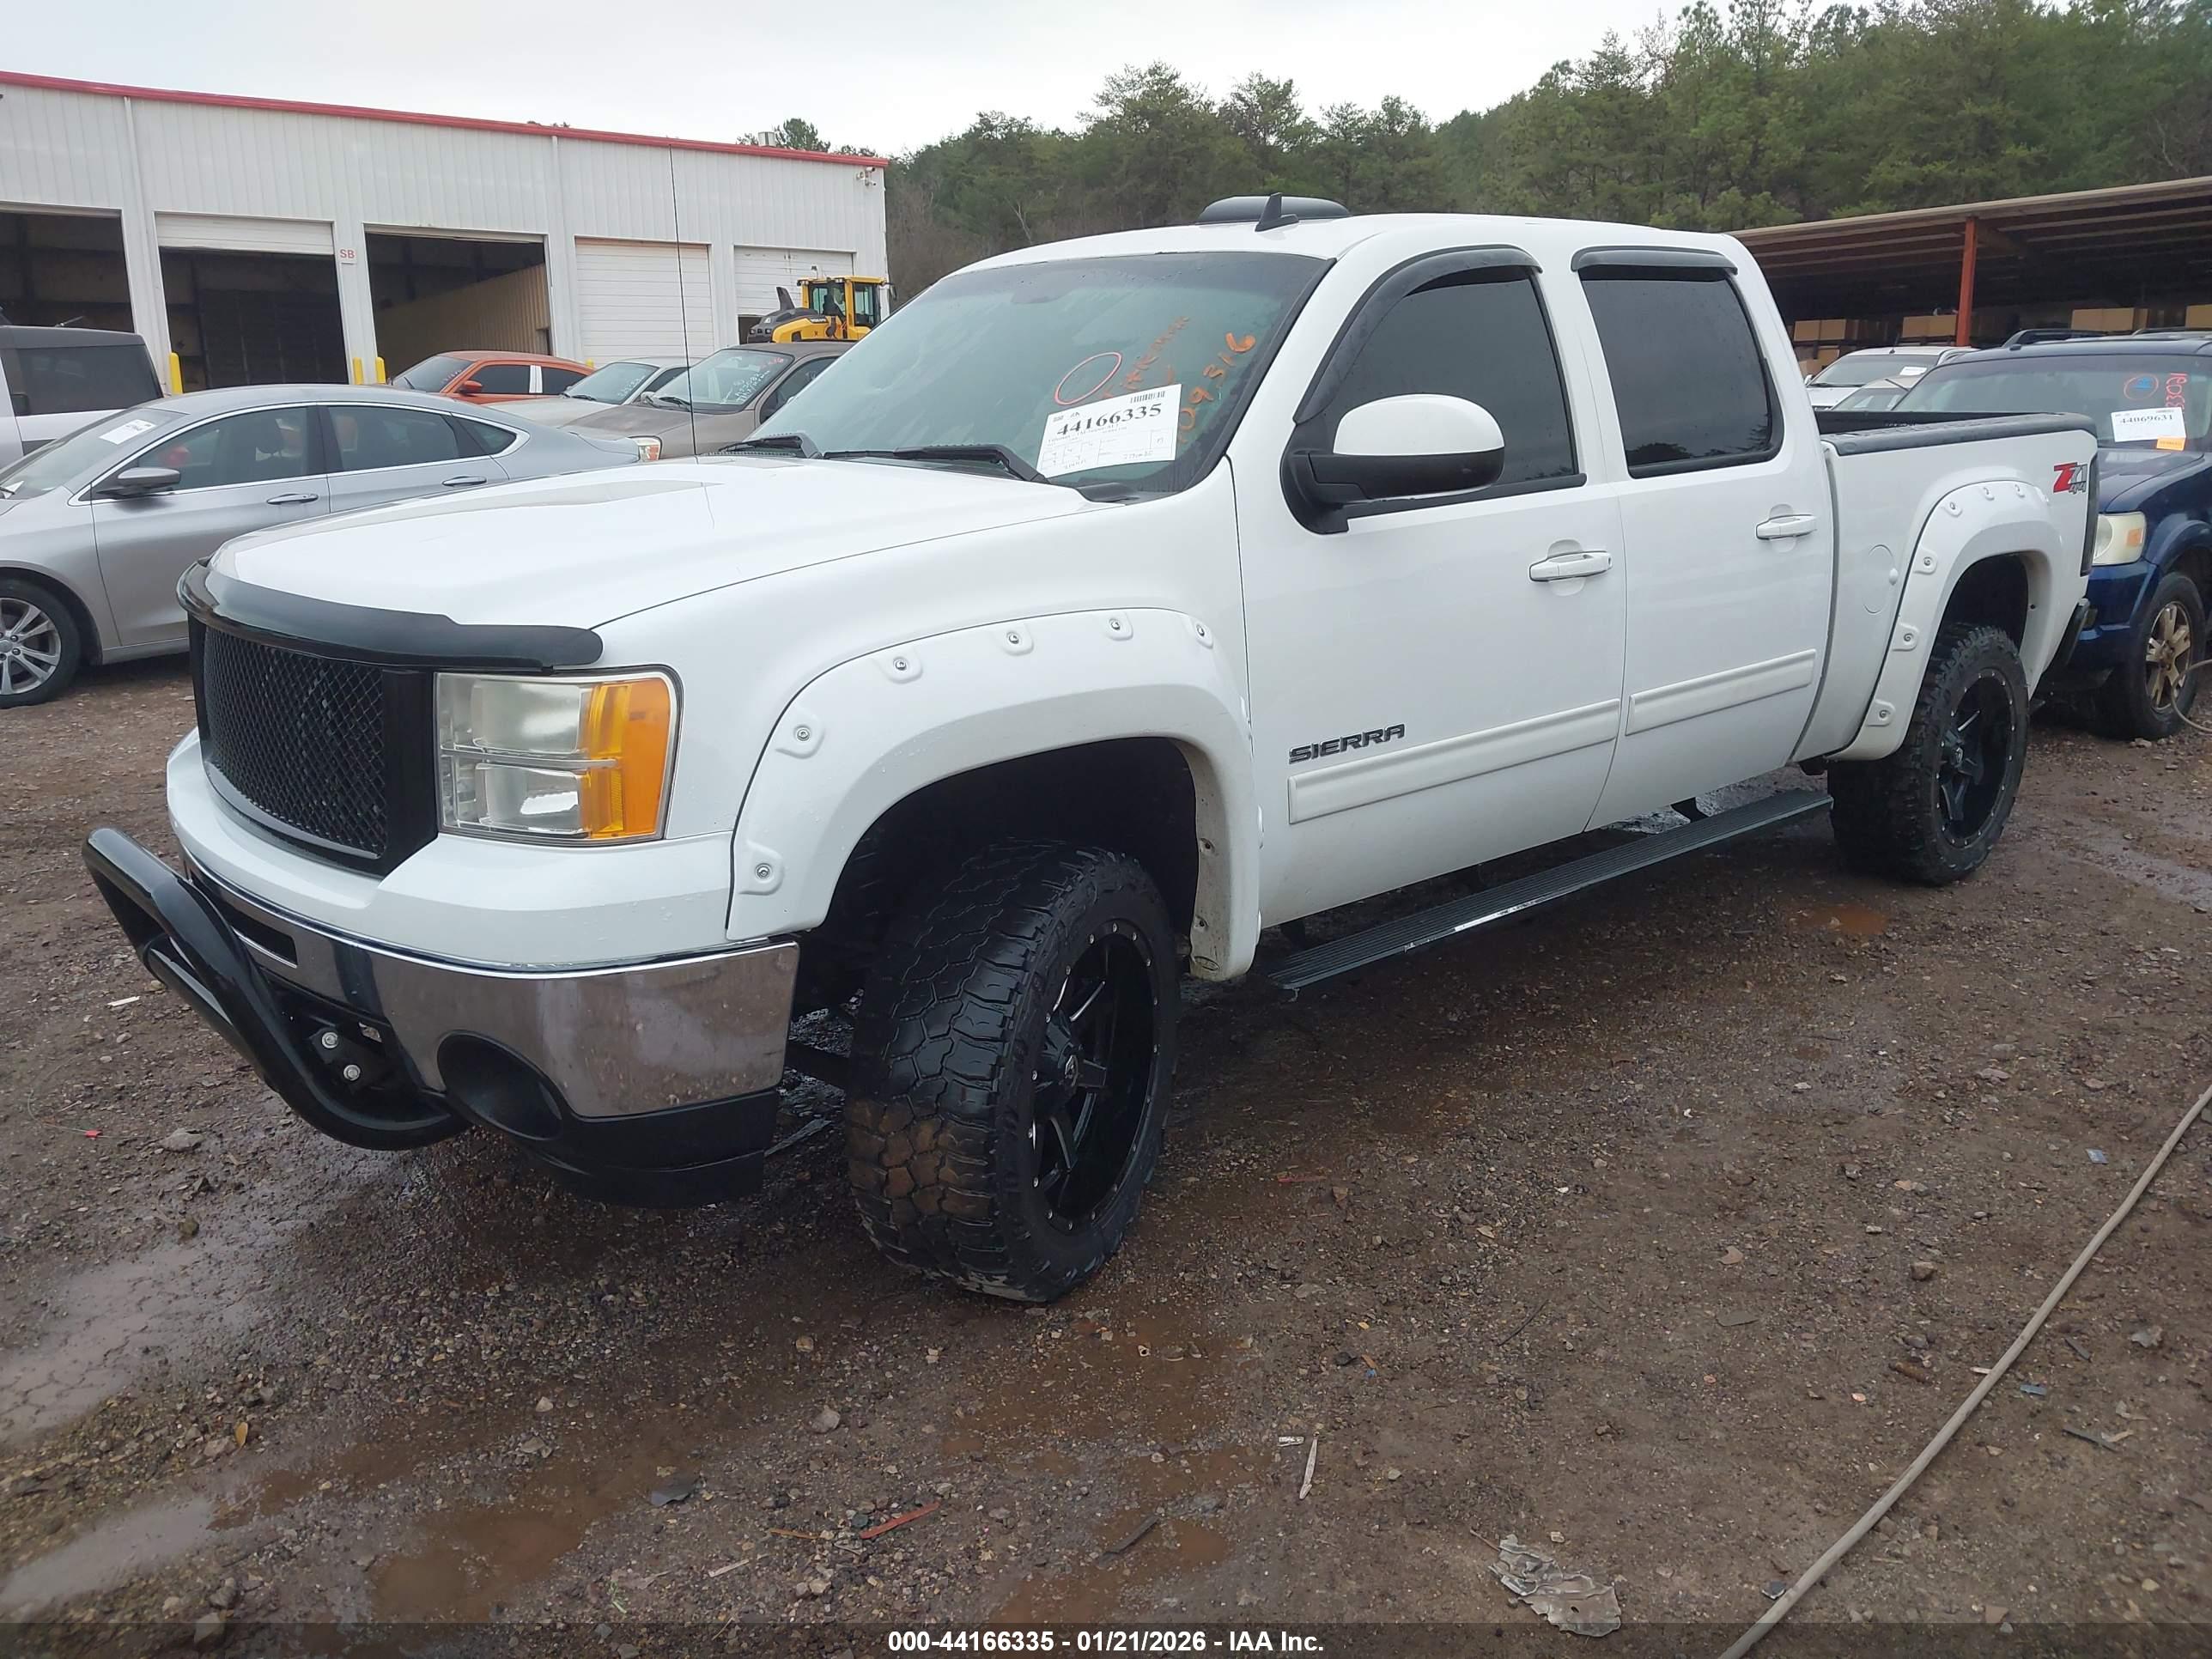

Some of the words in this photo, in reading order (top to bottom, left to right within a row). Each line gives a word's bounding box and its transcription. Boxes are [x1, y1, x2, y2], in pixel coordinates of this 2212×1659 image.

[339, 248, 356, 258] SB
[1056, 403, 1163, 435] 44166335
[1288, 723, 1406, 764] SIERRA
